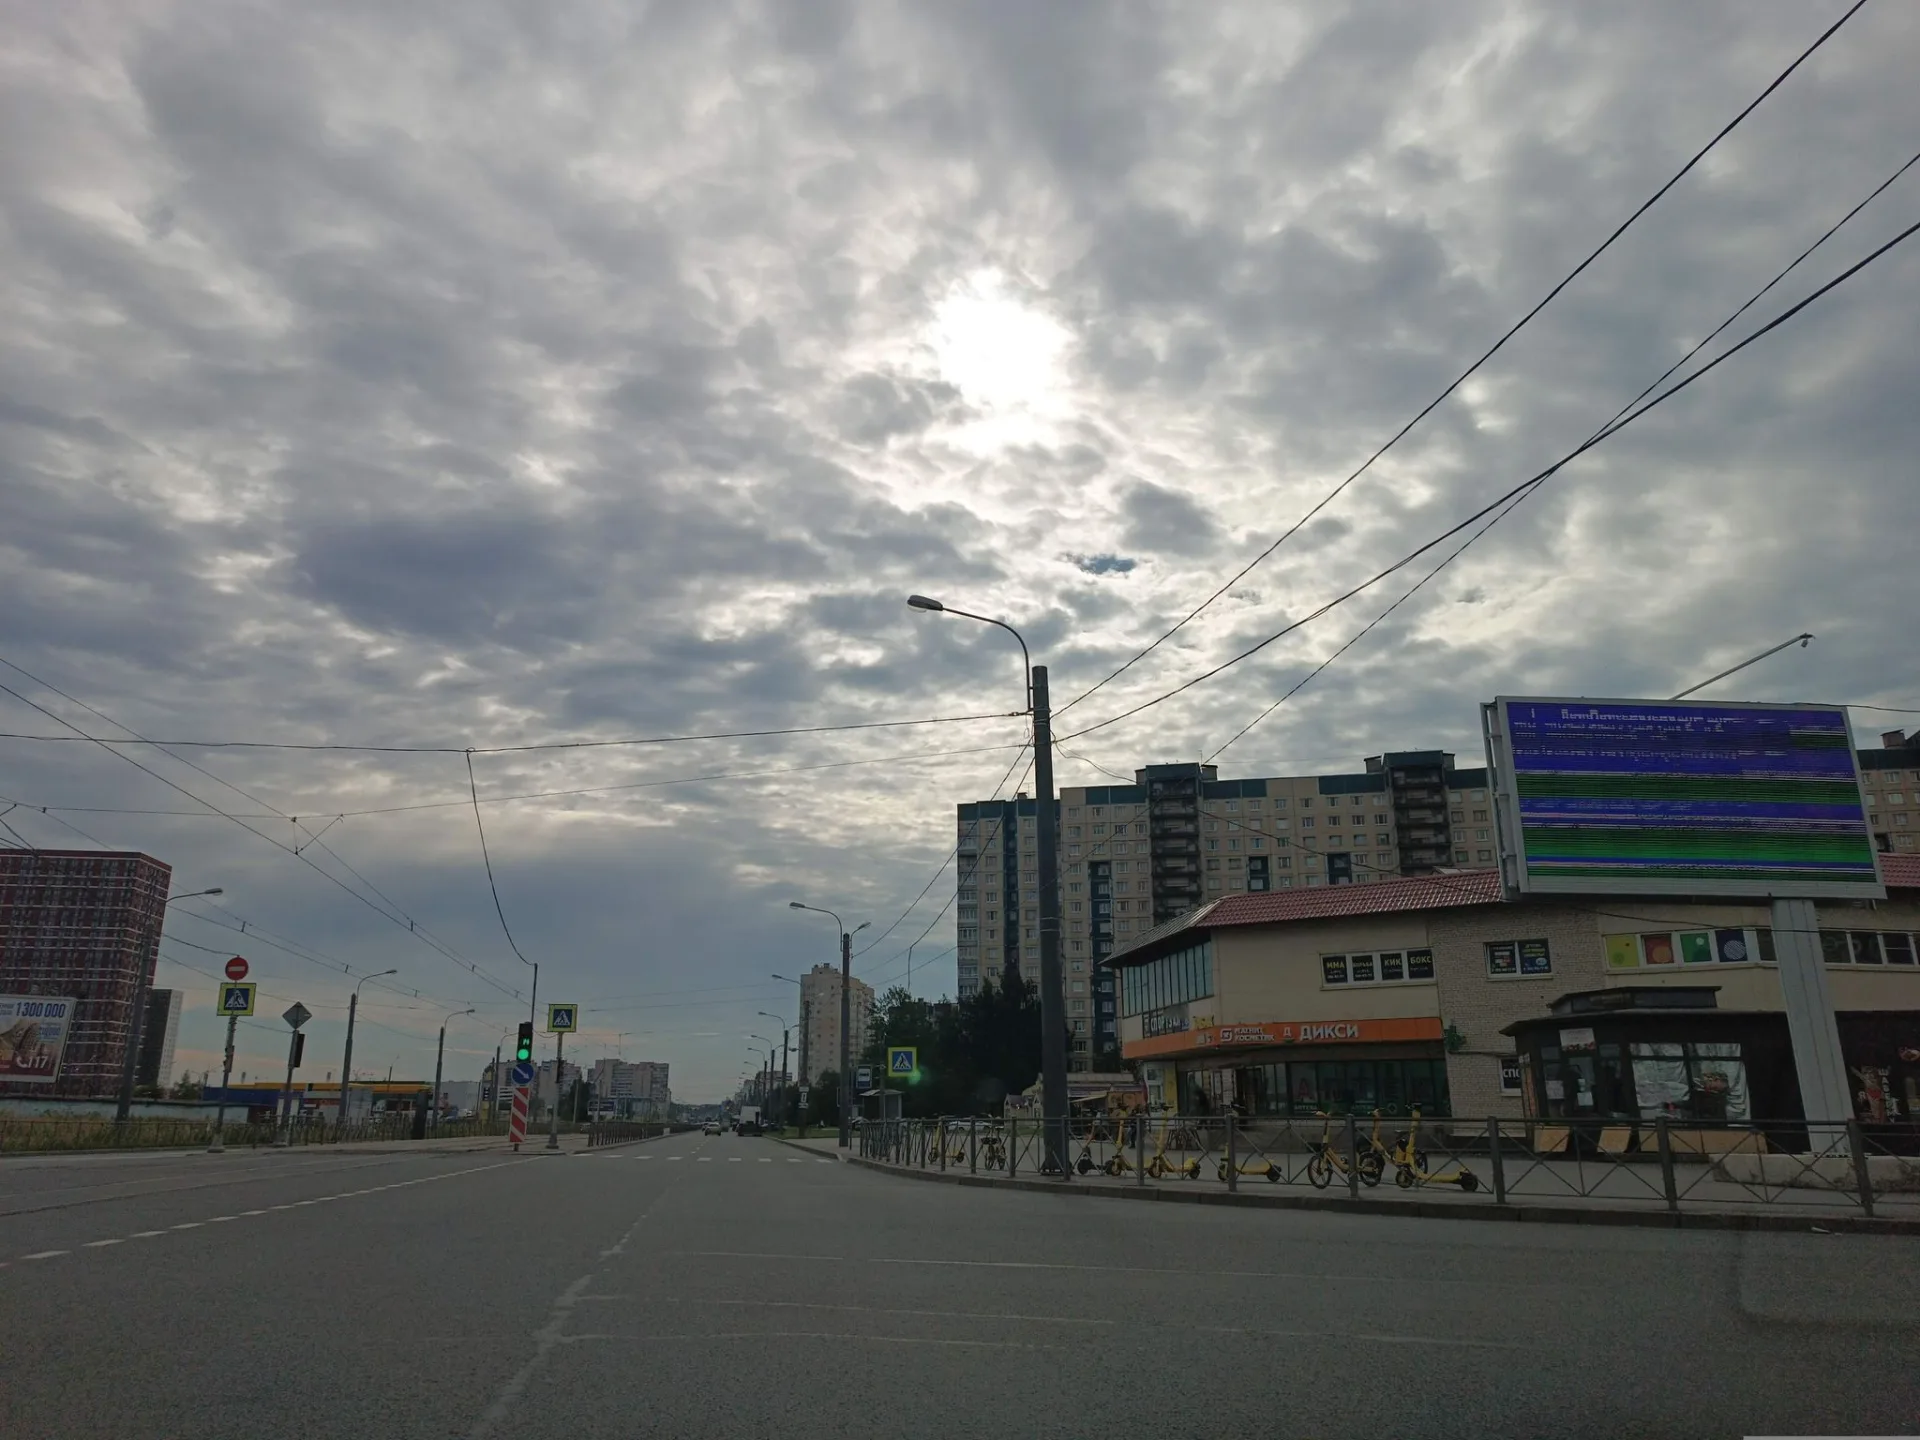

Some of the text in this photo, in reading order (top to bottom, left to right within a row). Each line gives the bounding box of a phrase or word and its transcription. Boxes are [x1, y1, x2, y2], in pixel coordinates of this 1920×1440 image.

[1384, 955, 1432, 967] КИК БОКС
[1299, 1024, 1359, 1041] ДИКСИ
